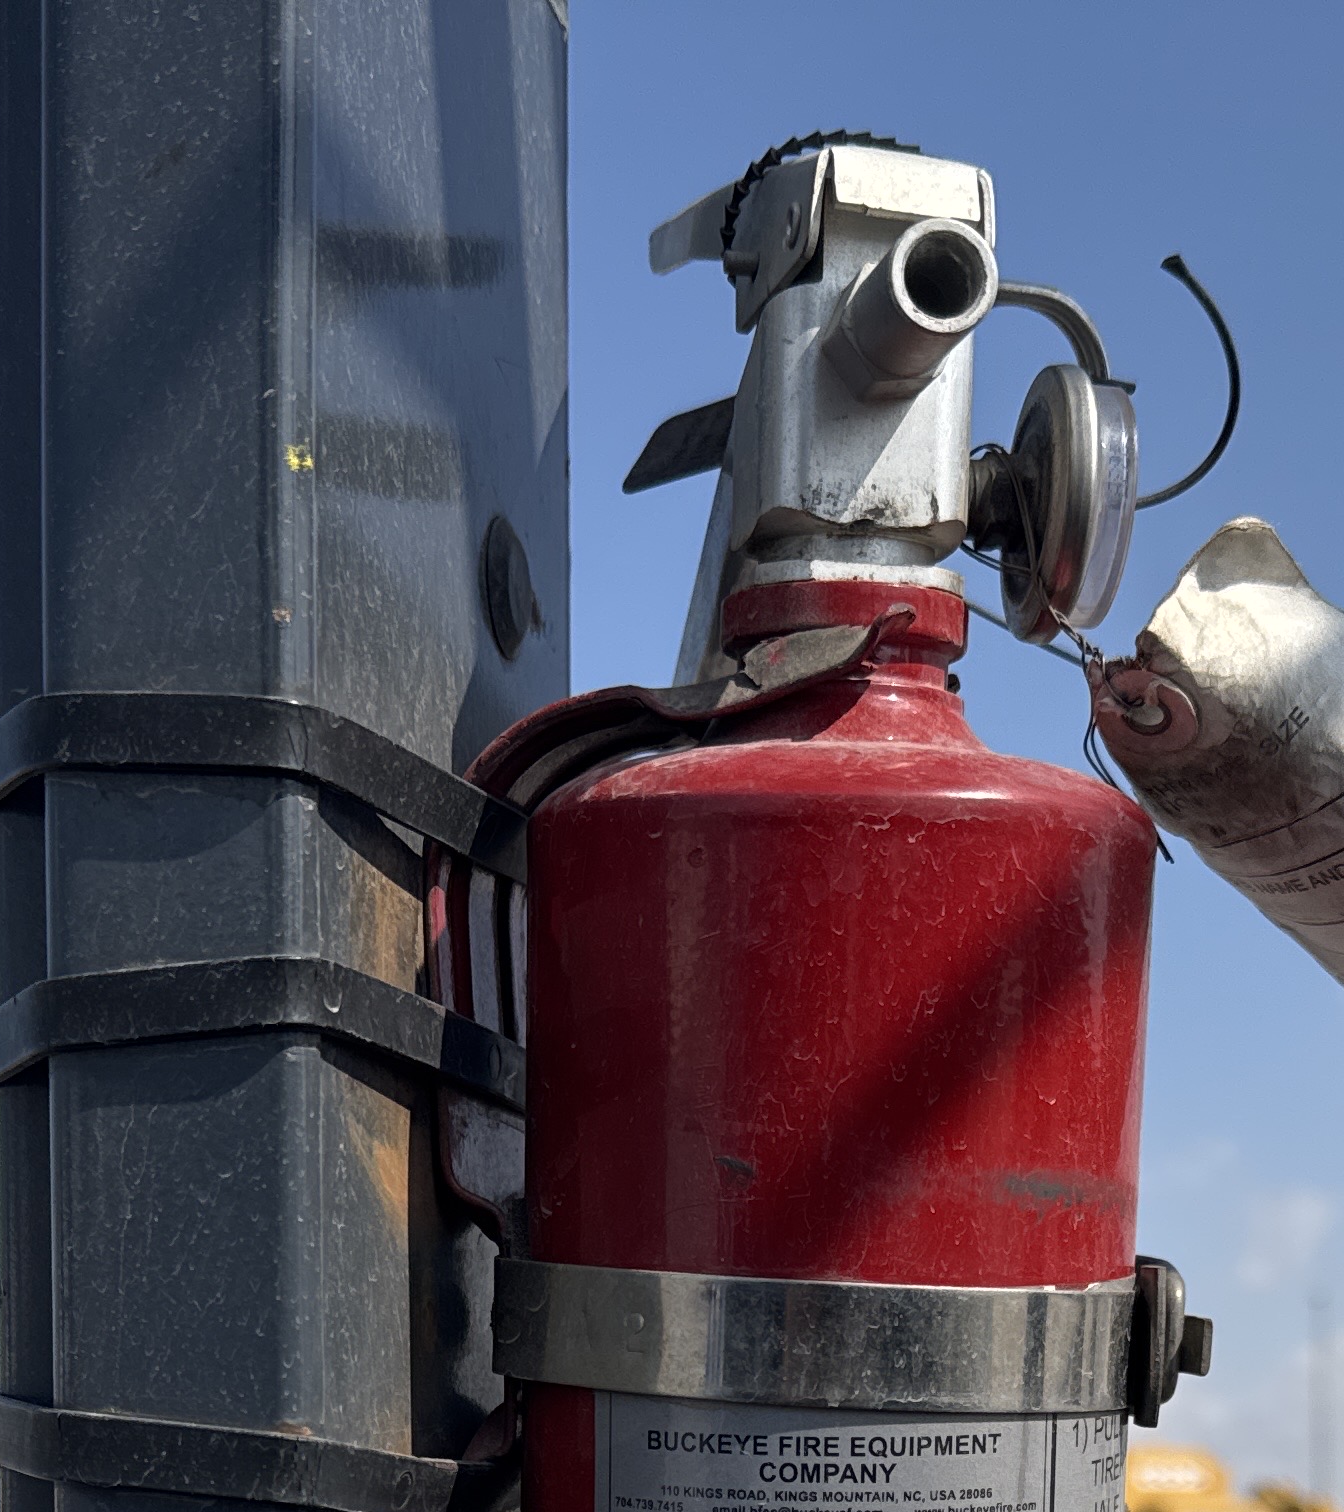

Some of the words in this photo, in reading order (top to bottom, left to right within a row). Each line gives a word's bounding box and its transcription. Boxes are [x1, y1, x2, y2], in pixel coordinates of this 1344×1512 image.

[1260, 705, 1310, 757] SIZE
[647, 1429, 768, 1456] BUCKEYE
[778, 1436, 839, 1457] FIRE
[850, 1432, 1002, 1458] EQUIPMENT
[1072, 1418, 1088, 1454] 1)
[758, 1461, 897, 1484] COMPANY
[660, 1484, 680, 1496] 110
[683, 1486, 723, 1499] KINGS
[727, 1488, 766, 1501] ROAD,
[774, 1490, 817, 1502] KINGS
[822, 1491, 898, 1504] MOUNTAIN,
[929, 1489, 956, 1501] USA
